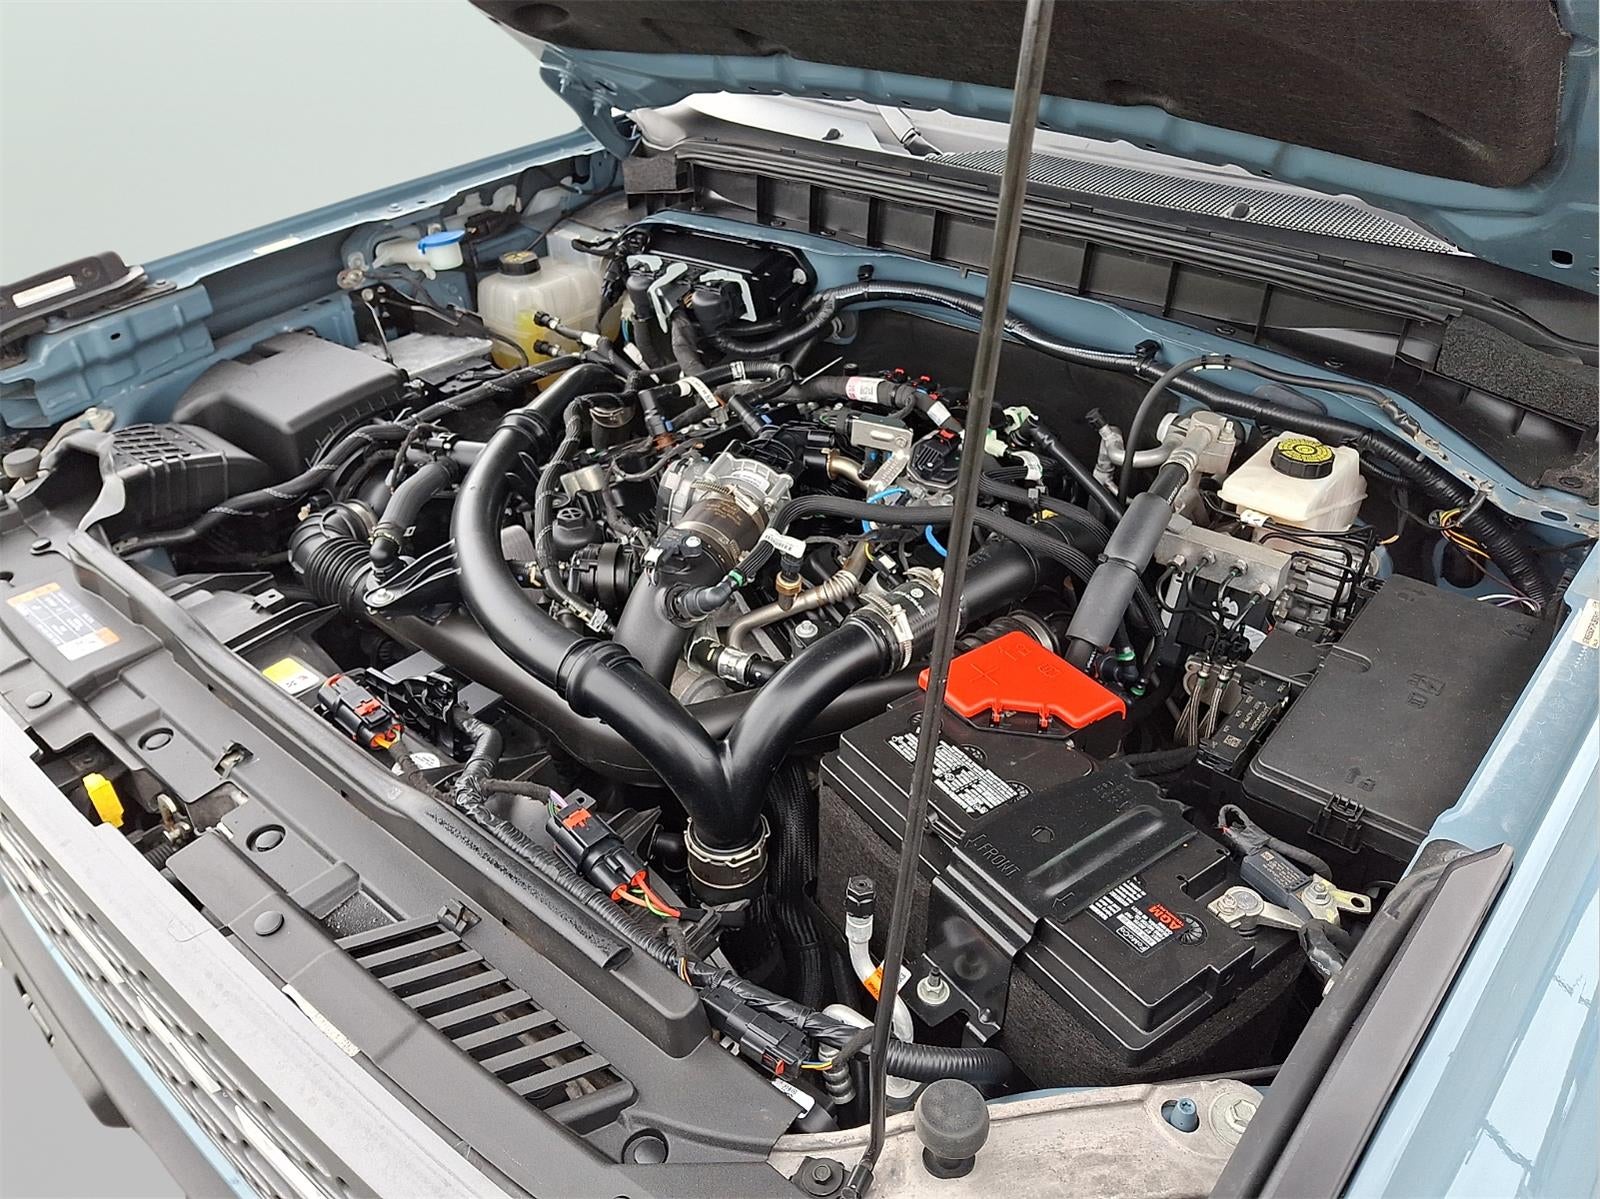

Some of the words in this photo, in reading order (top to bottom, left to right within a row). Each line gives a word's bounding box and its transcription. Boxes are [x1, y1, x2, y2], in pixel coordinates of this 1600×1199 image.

[979, 845, 1021, 877] FRONT
[1148, 905, 1181, 930] AGM
[1119, 927, 1150, 952] FoMoCo
